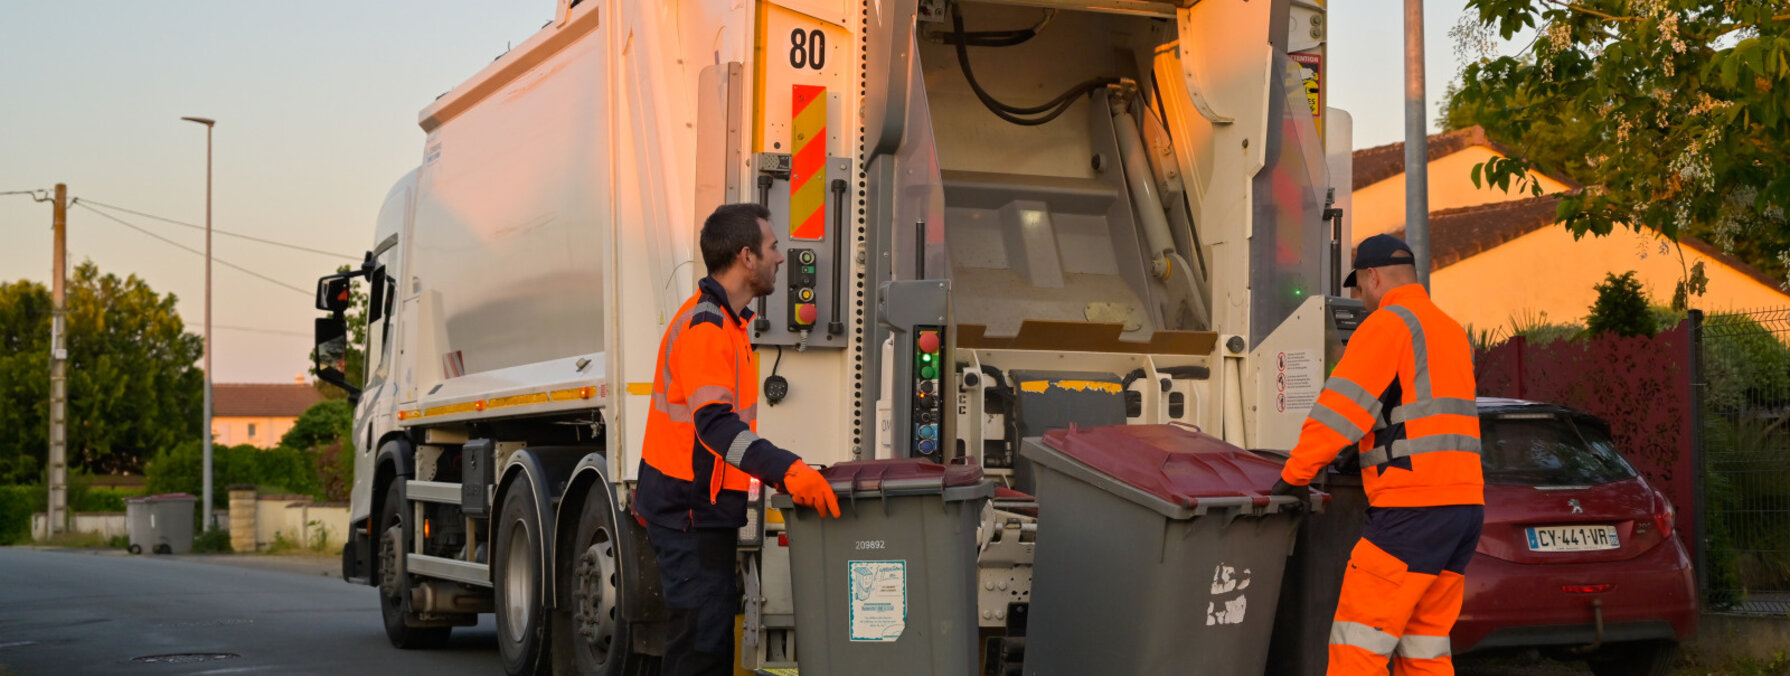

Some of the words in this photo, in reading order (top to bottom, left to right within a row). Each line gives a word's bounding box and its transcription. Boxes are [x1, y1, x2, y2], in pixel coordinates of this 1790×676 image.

[790, 27, 825, 70] 80
[855, 540, 886, 551] 209892
[1538, 528, 1609, 547] CY-441-VR
